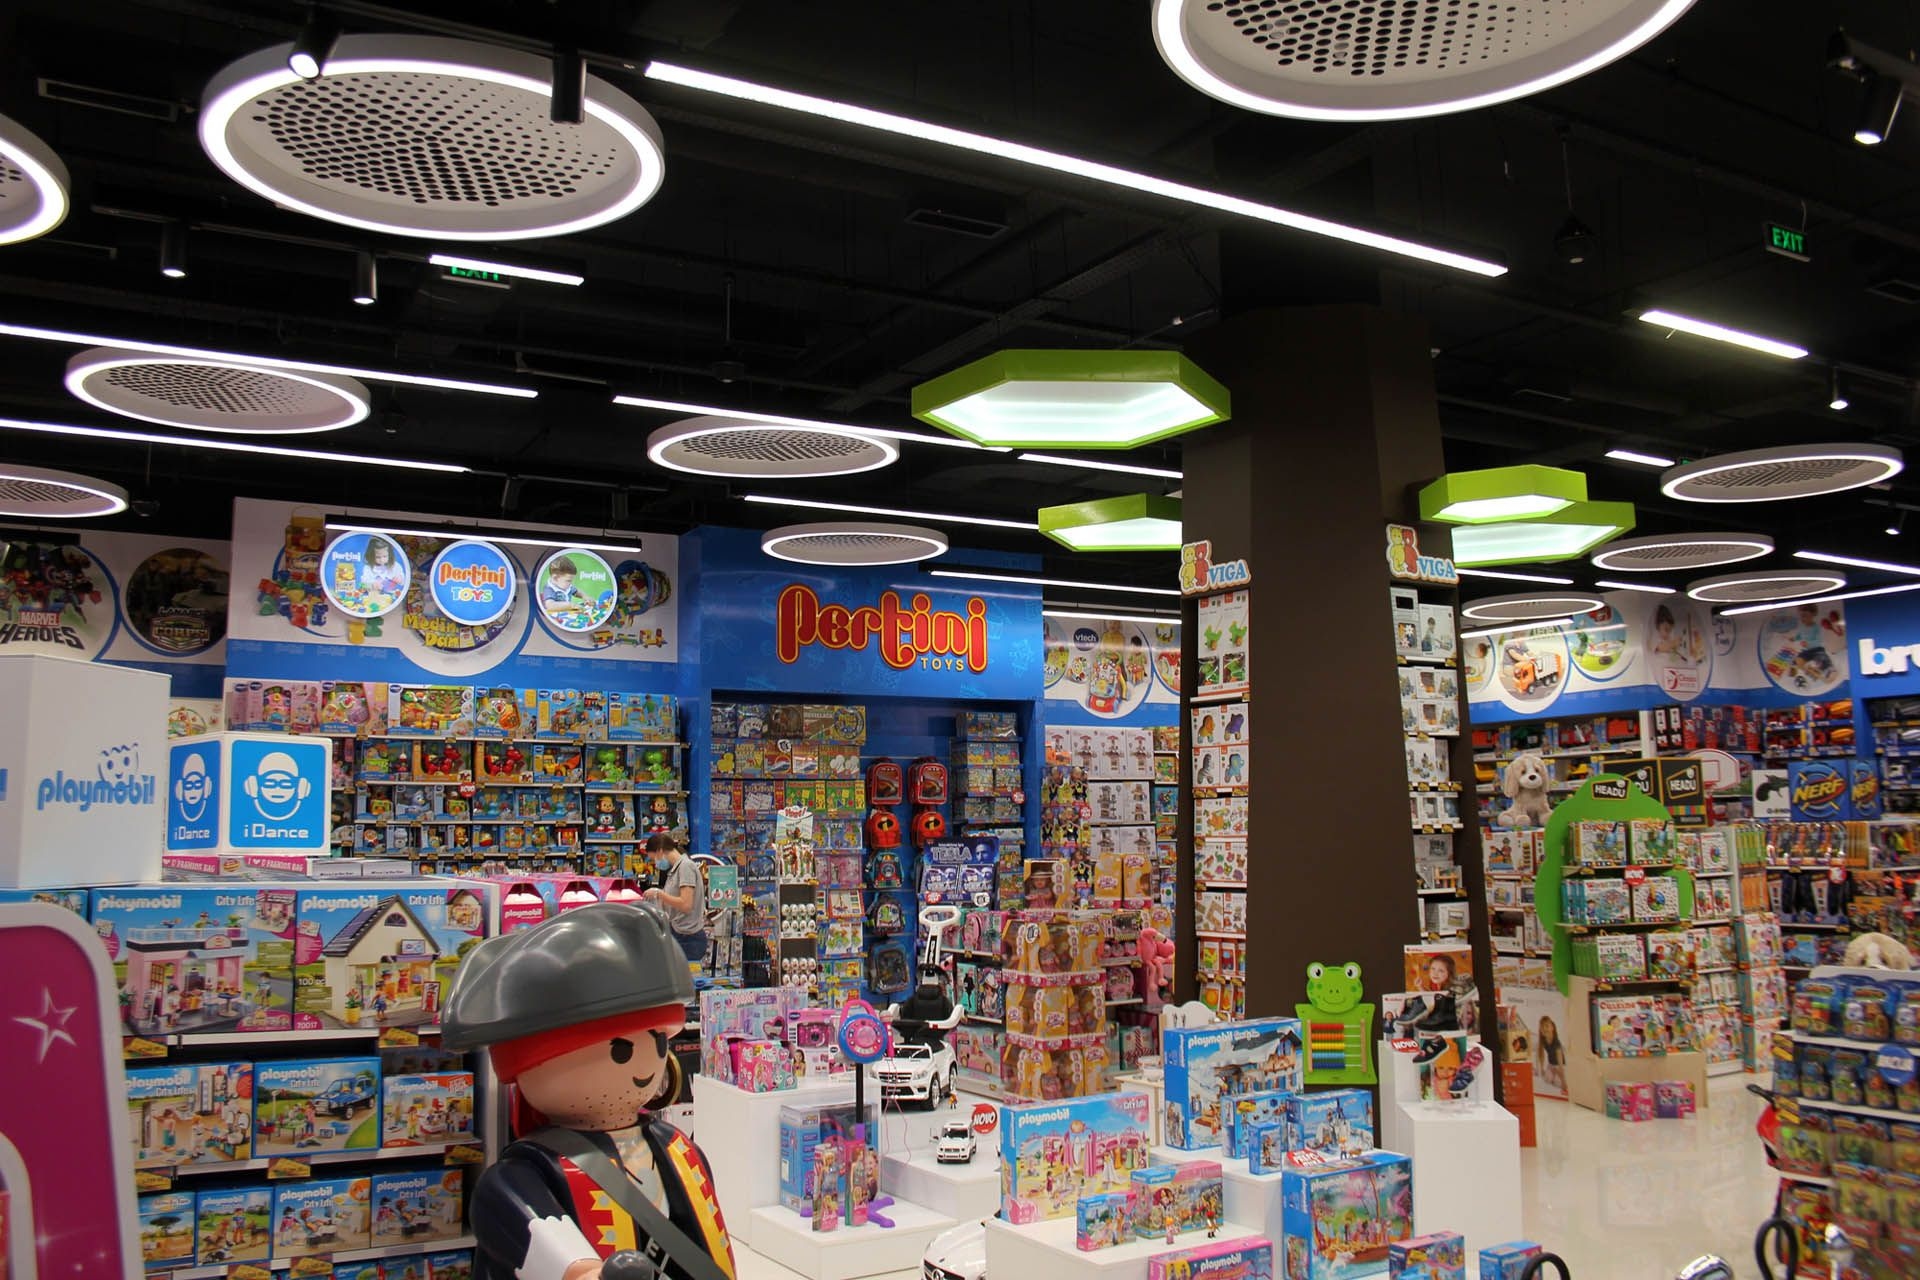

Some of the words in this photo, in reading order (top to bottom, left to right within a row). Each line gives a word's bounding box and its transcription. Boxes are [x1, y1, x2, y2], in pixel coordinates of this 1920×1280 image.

[1772, 226, 1804, 253] EXIT
[439, 561, 507, 588] Pertini
[1208, 560, 1247, 582] VIGA
[1417, 557, 1457, 579] VIGA
[451, 587, 494, 602] TOYS
[19, 611, 60, 626] MARVEL
[0, 622, 85, 650] HEROES
[777, 583, 988, 674] Pertini
[1075, 633, 1097, 642] vtech
[920, 657, 964, 671] TOYS
[37, 770, 156, 812] playmobil
[1594, 782, 1627, 798] HEADU
[1670, 779, 1697, 791] HEADU
[1793, 777, 1844, 803] NERF
[1852, 777, 1878, 800] NERF
[930, 846, 972, 861] TESLA
[97, 894, 182, 912] playmobil
[215, 895, 236, 906] City
[302, 895, 378, 912] playmobil
[409, 895, 427, 905] City
[504, 908, 543, 919] playmobil
[1188, 1032, 1233, 1048] playmobil
[1393, 1039, 1418, 1049] NOVO
[259, 1066, 323, 1083] playmobil
[973, 1111, 996, 1125] NOVO
[1018, 1108, 1070, 1127] playmobil
[376, 1177, 427, 1193] playmobil
[280, 1186, 333, 1202] playmobil
[1200, 1254, 1243, 1272] playmobil
